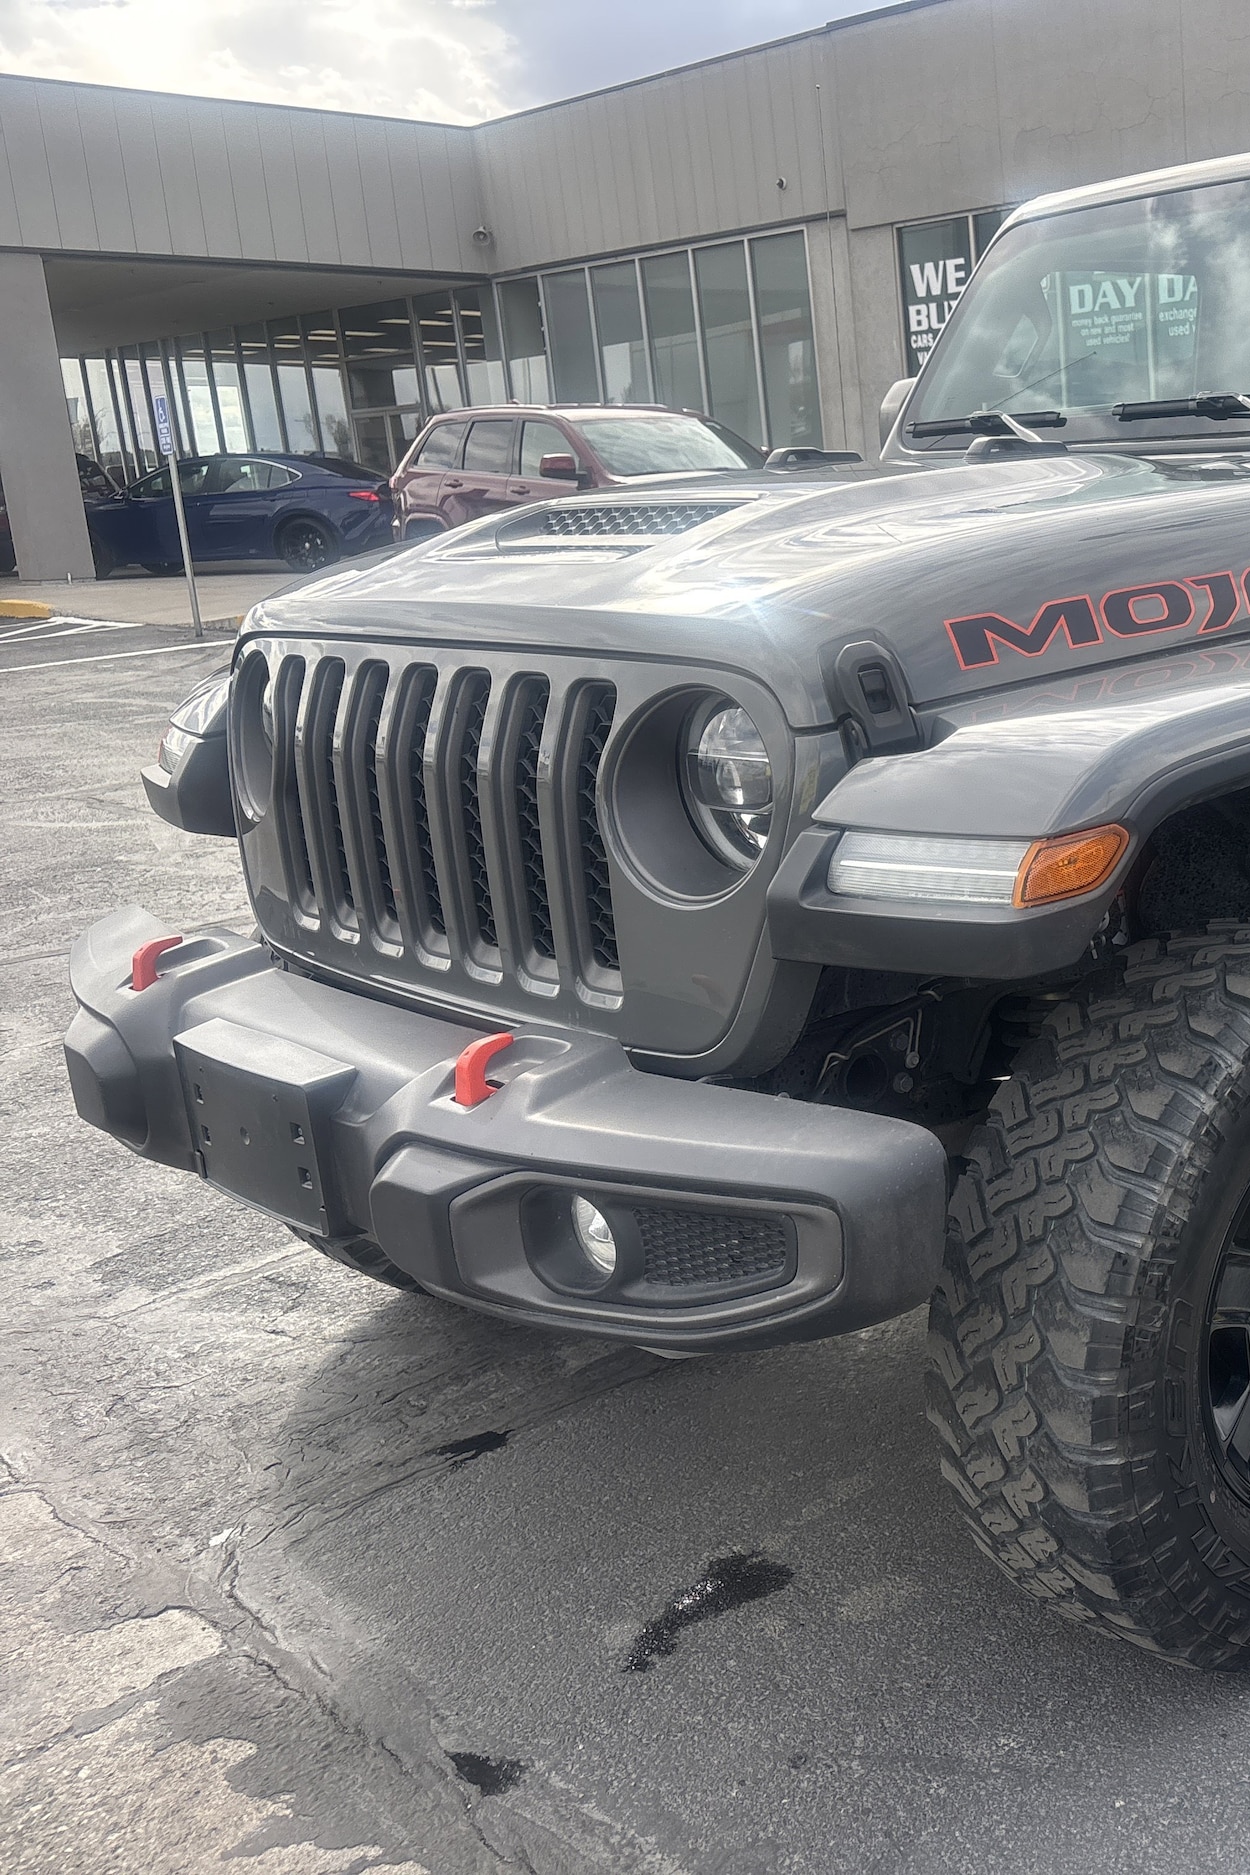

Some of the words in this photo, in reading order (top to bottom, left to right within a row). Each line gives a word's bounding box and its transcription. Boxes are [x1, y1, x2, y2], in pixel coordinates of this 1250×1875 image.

[909, 257, 966, 298] WE
[1069, 276, 1142, 315] DAY
[911, 333, 934, 349] CARS
[1168, 321, 1190, 336] used
